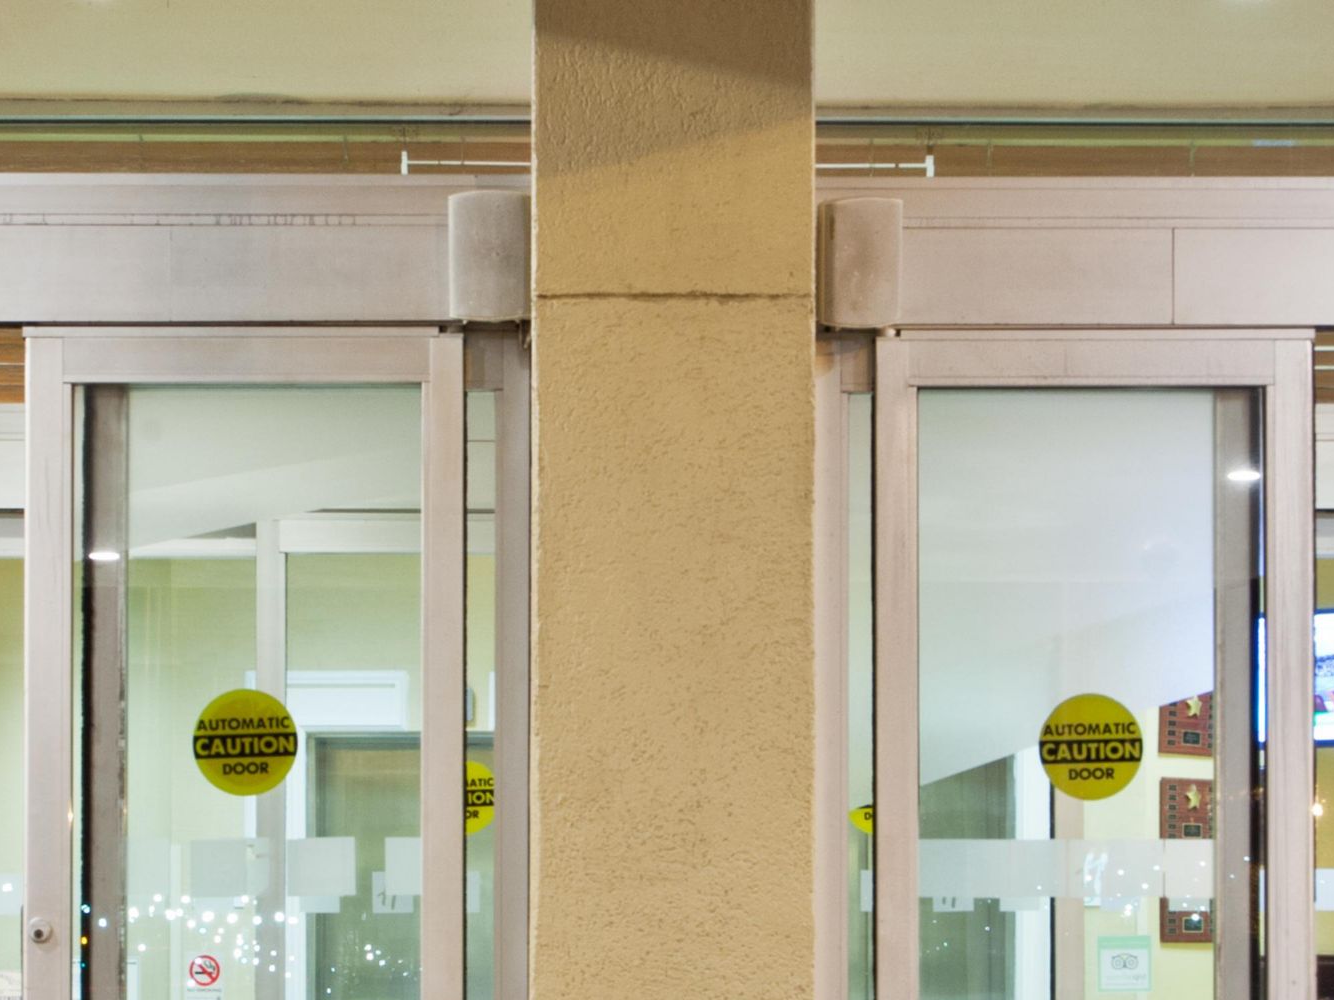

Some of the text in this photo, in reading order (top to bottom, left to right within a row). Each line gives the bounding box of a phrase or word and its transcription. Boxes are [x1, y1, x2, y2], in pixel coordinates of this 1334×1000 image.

[197, 717, 290, 732] AUTOMATIC
[1044, 722, 1136, 736] AUTOMATIC
[195, 735, 295, 756] CAUTION
[1042, 741, 1140, 761] CAUTION
[222, 762, 269, 775] DOOR
[1068, 767, 1115, 780] DOOR
